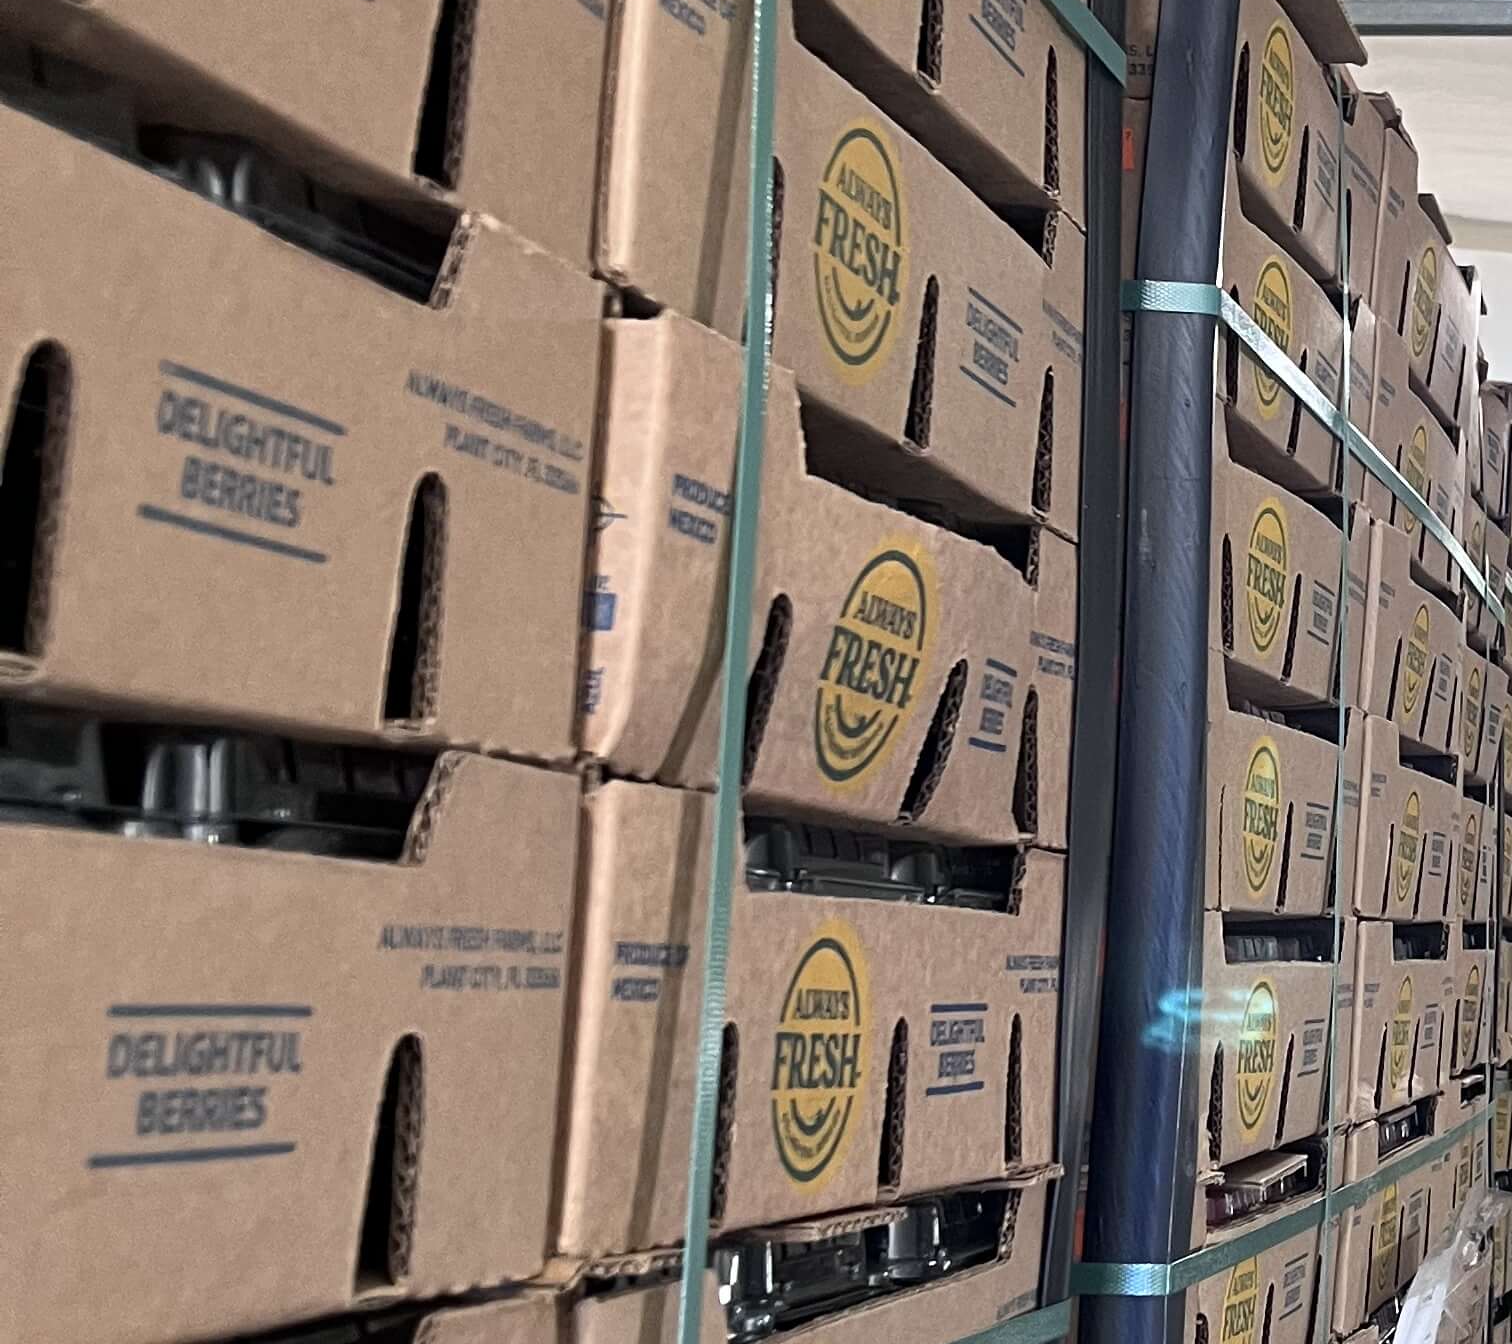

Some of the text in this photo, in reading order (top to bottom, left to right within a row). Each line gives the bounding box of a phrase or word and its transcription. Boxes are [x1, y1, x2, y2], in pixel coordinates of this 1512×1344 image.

[836, 162, 892, 231] ALWAYS
[815, 188, 901, 307] FRESH
[157, 389, 335, 486] DELIGHTFUL
[180, 456, 305, 528] BERRIES
[1247, 552, 1287, 609] FRESH
[853, 591, 918, 641] ALWAYS
[820, 624, 921, 710] FRESH
[792, 988, 850, 1021] ALWAYS
[106, 1030, 303, 1079] DELIGHTFUL
[772, 1031, 861, 1091] FRESH
[134, 1086, 269, 1136] BERRIES
